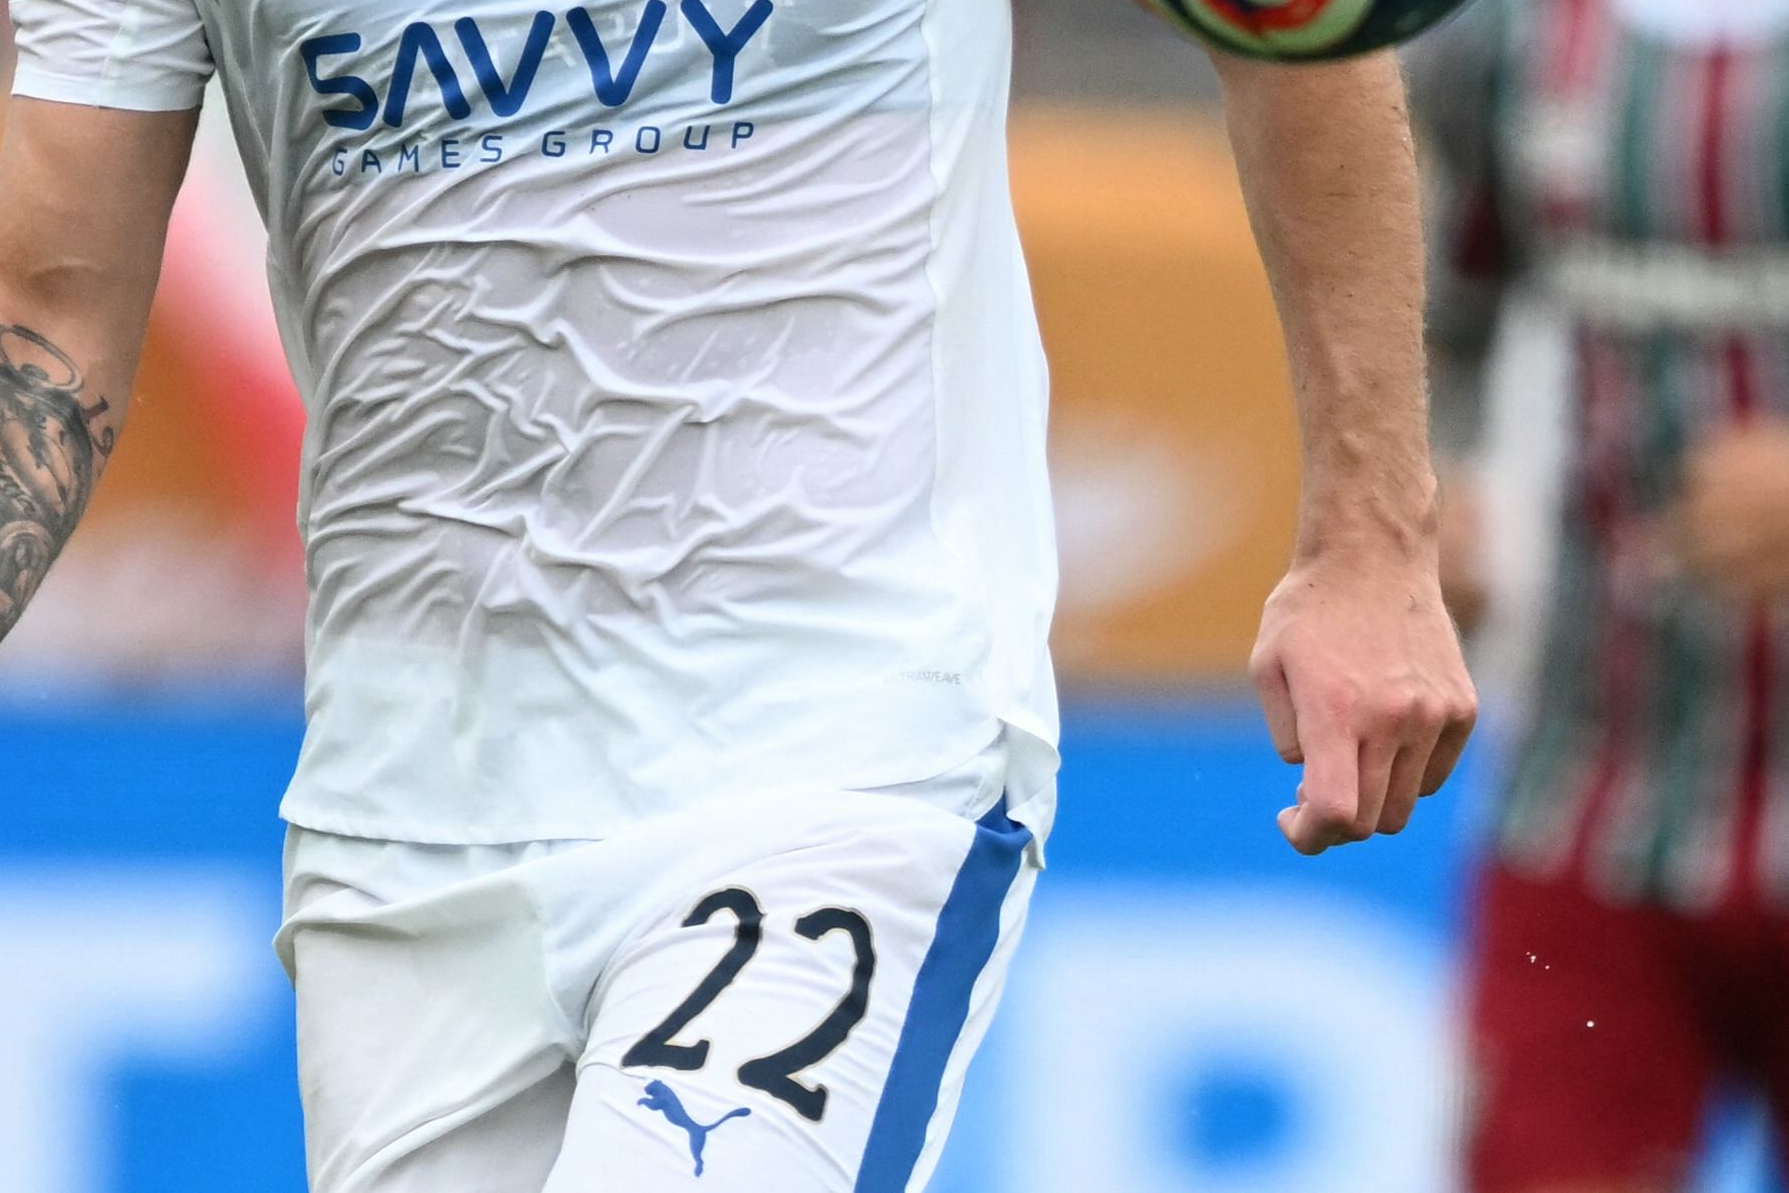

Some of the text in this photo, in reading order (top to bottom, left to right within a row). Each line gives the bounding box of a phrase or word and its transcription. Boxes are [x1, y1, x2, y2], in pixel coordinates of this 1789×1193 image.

[332, 121, 754, 177] GAMES GROUP
[621, 887, 875, 1123] 22
